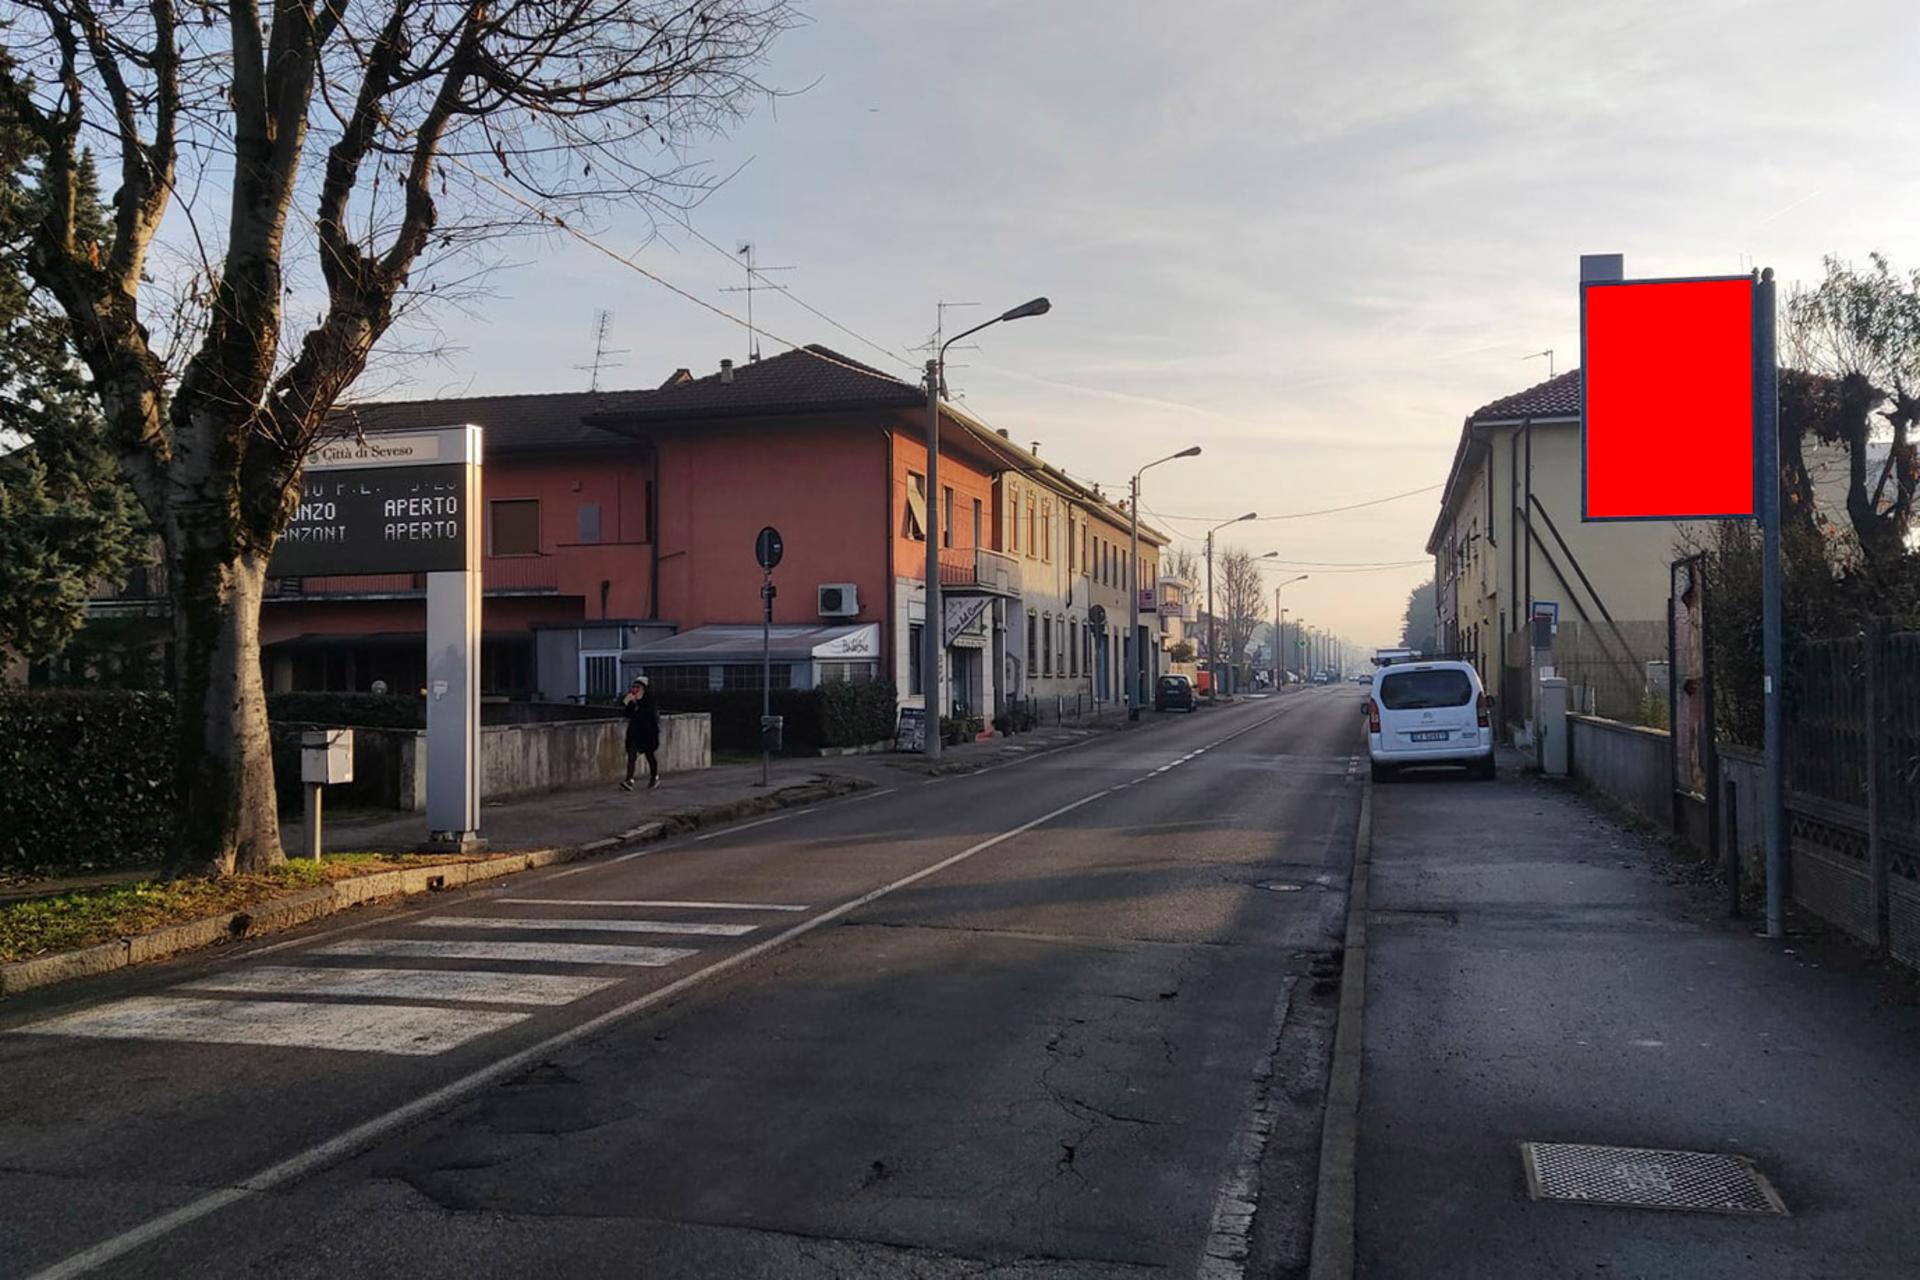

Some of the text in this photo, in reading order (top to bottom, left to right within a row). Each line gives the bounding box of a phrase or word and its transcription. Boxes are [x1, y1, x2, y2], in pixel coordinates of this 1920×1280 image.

[322, 445, 414, 461] Città di Seveso
[384, 496, 457, 517] APERTO
[384, 520, 457, 541] APERTO
